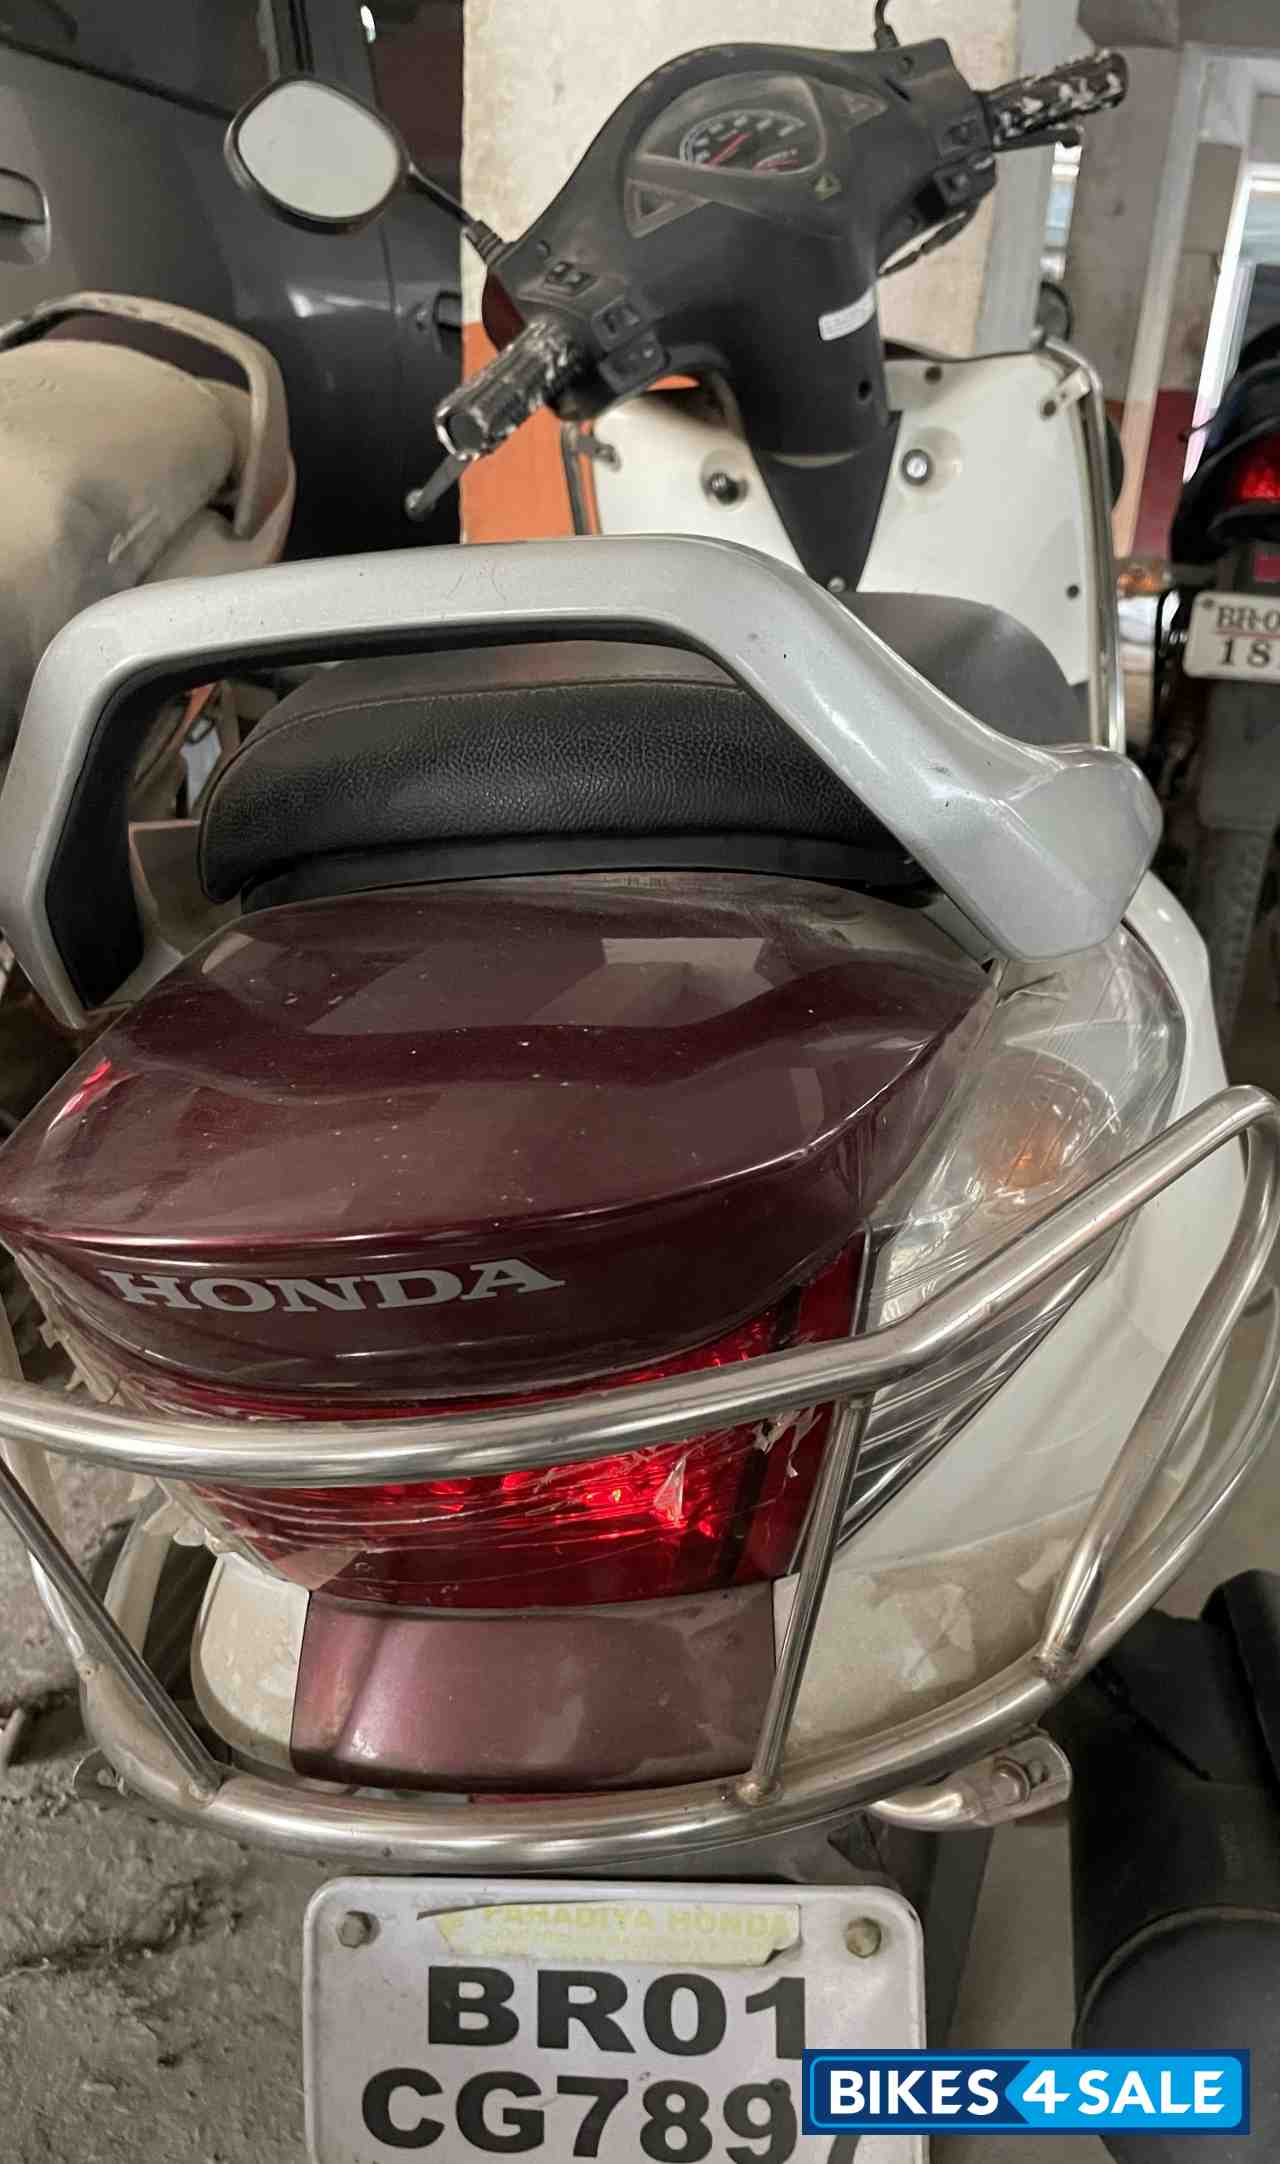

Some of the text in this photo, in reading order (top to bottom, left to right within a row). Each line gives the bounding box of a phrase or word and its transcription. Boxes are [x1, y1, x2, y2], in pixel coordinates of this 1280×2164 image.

[98, 1258, 566, 1313] HONDA
[427, 1965, 807, 2060] BR01
[361, 2067, 863, 2164] CG789
